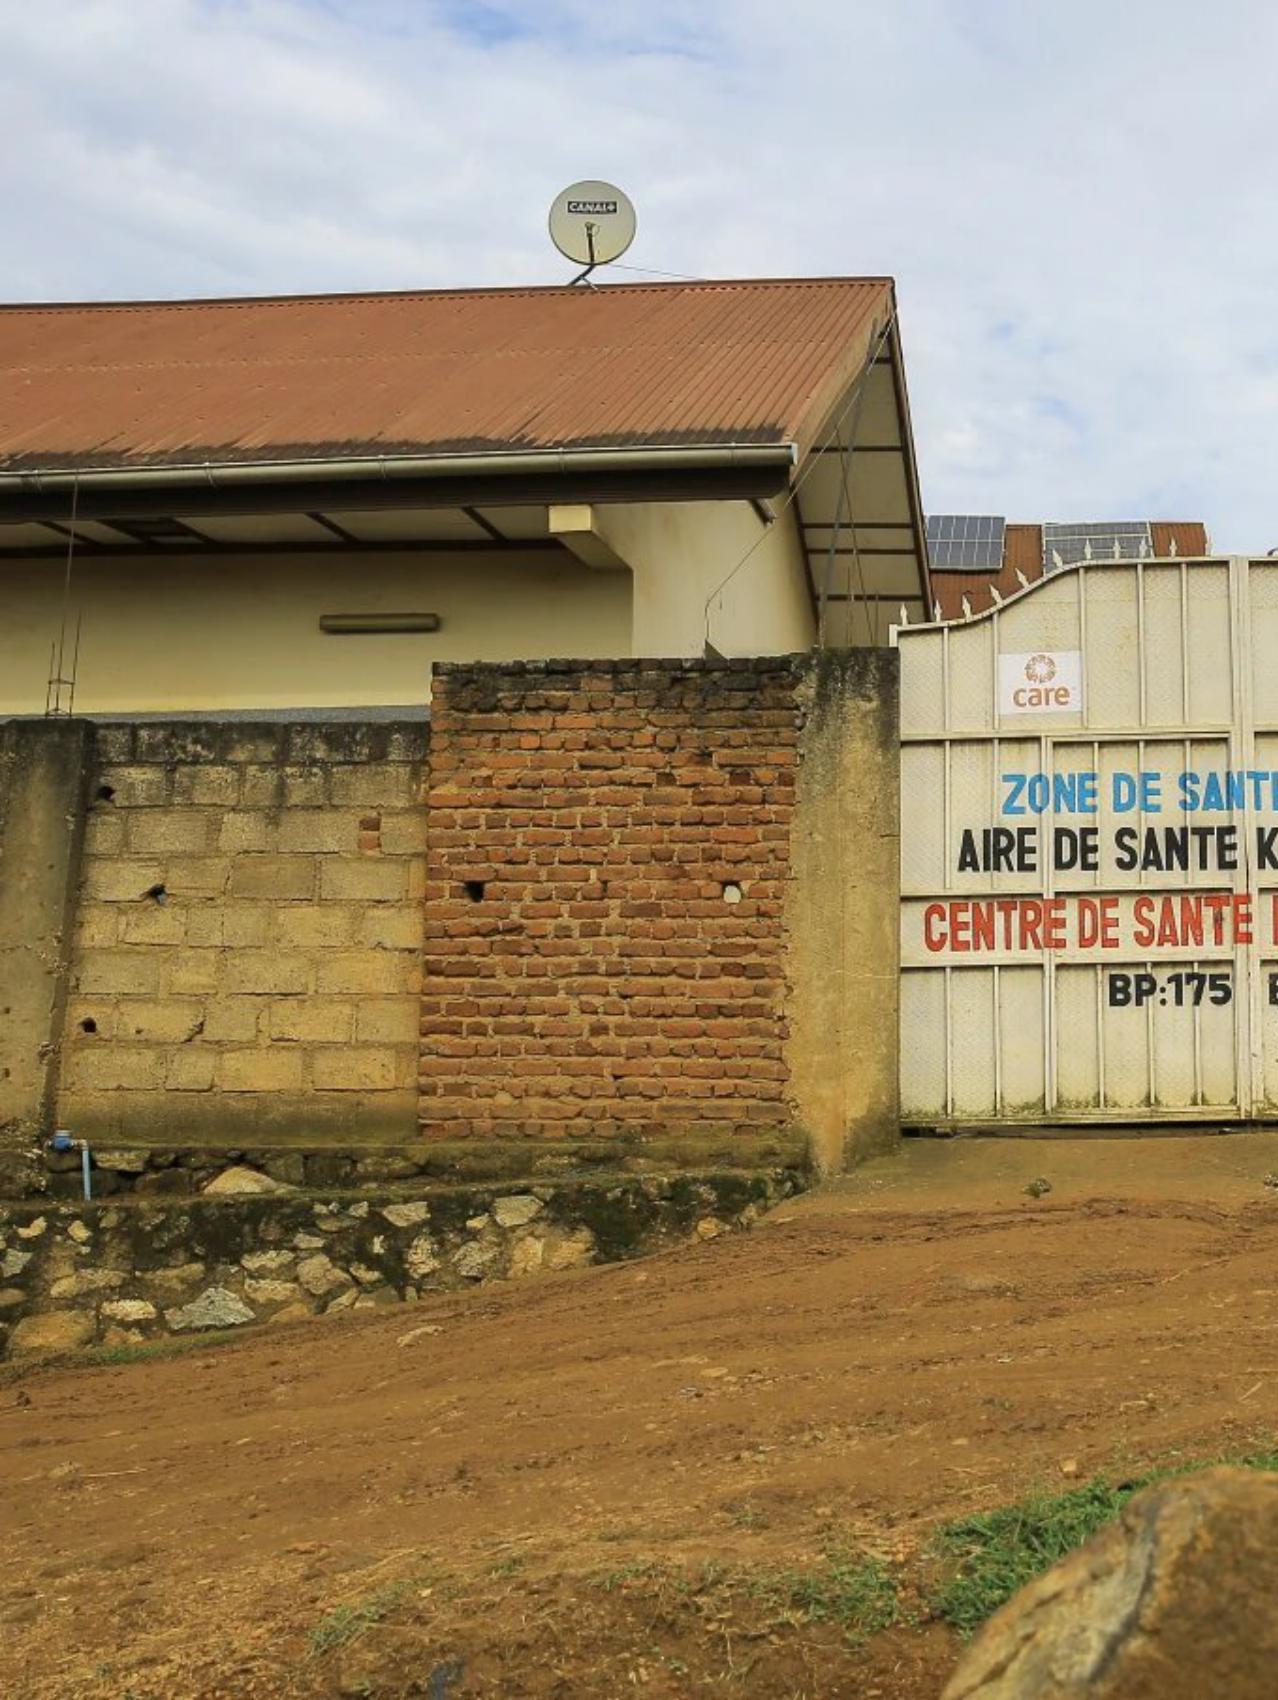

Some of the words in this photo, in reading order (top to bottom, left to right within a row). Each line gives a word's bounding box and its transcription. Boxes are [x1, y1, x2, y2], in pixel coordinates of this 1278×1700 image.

[1013, 683, 1070, 708] care
[1001, 773, 1098, 814] ZONE
[1112, 773, 1161, 812] DE
[958, 828, 1037, 872] AIRE
[1053, 827, 1098, 871] DE
[1115, 826, 1238, 870] SANTE
[923, 899, 1066, 952] CENTRE
[1078, 898, 1120, 949] DE
[1133, 895, 1253, 946] SANTE
[1108, 973, 1233, 1007] BP:175
